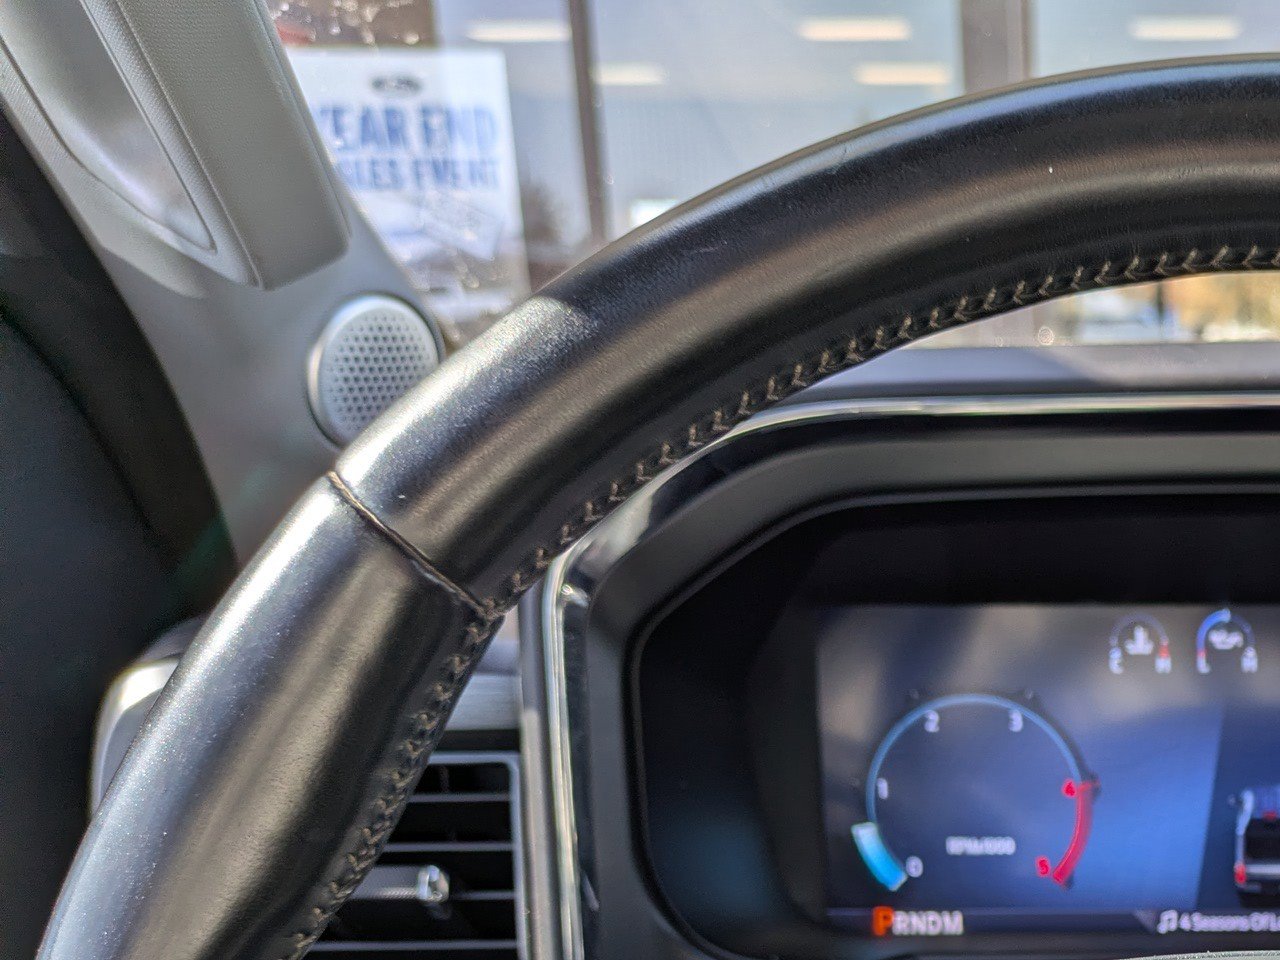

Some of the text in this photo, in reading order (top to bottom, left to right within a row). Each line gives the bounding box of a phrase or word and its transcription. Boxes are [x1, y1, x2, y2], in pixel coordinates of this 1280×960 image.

[924, 709, 940, 733] 2
[1008, 709, 1023, 733] 3
[876, 777, 888, 800] 1
[1062, 778, 1077, 798] 4
[904, 856, 923, 878] 0
[1035, 855, 1051, 877] 5
[1179, 912, 1191, 932] 4
